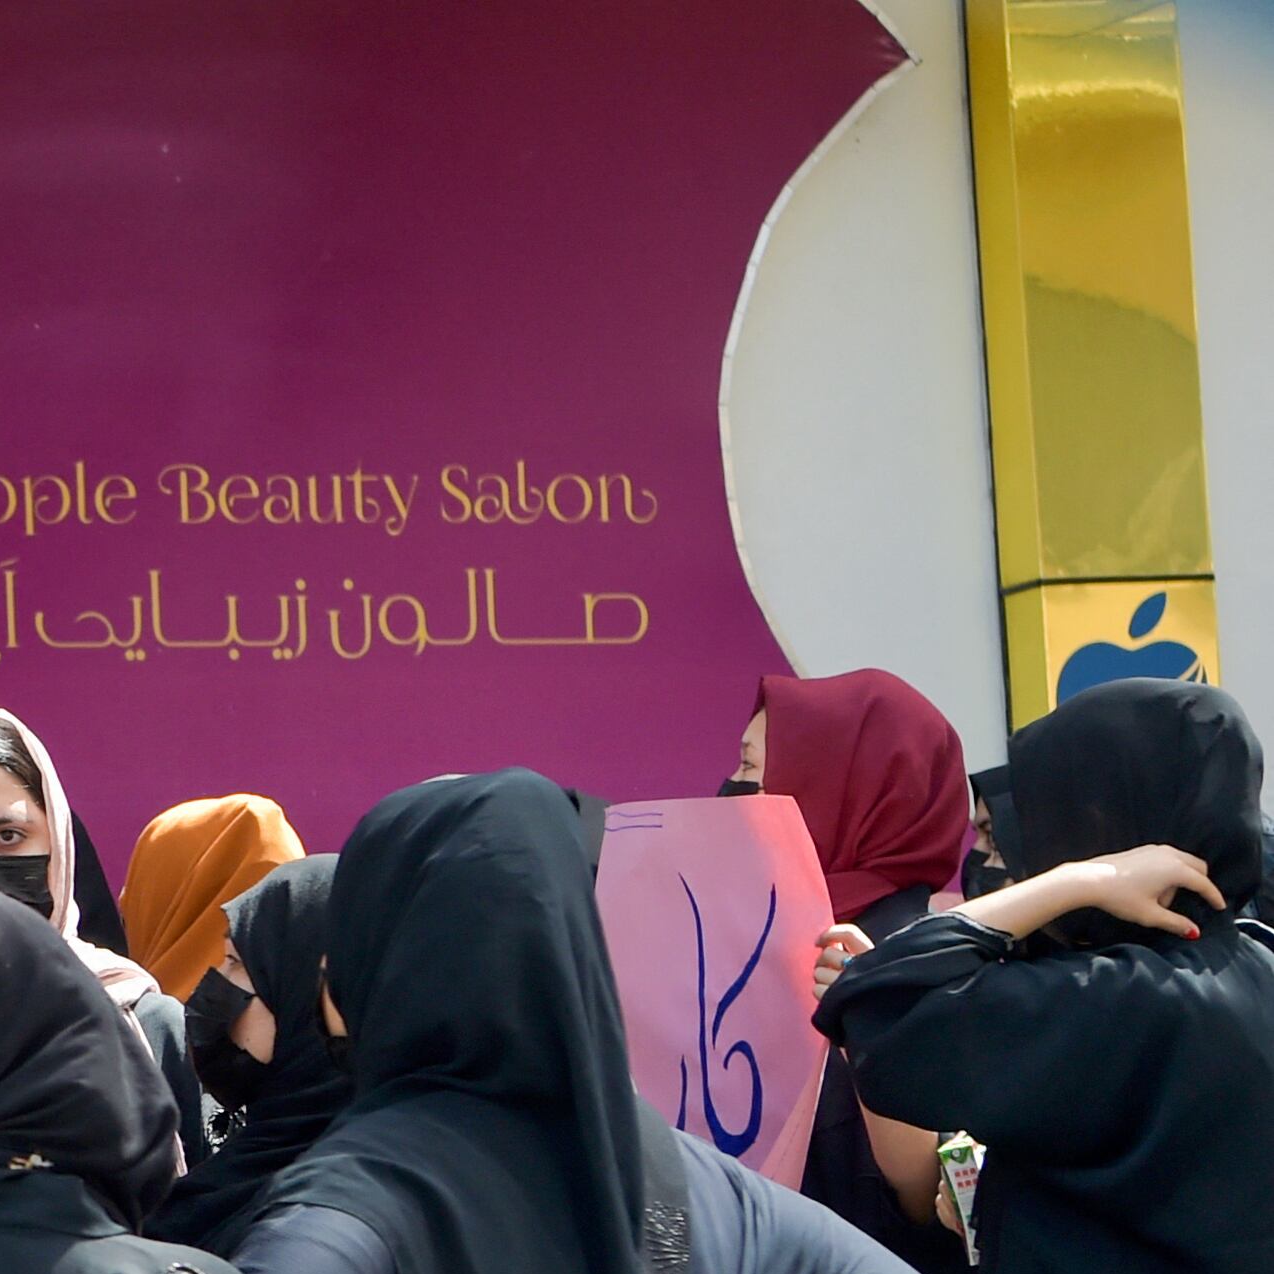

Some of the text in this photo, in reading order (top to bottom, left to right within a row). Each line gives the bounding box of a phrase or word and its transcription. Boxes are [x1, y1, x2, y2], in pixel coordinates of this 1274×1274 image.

[158, 463, 419, 536] Beauty
[439, 459, 658, 525] Salon
[328, 567, 650, 660] صالون
